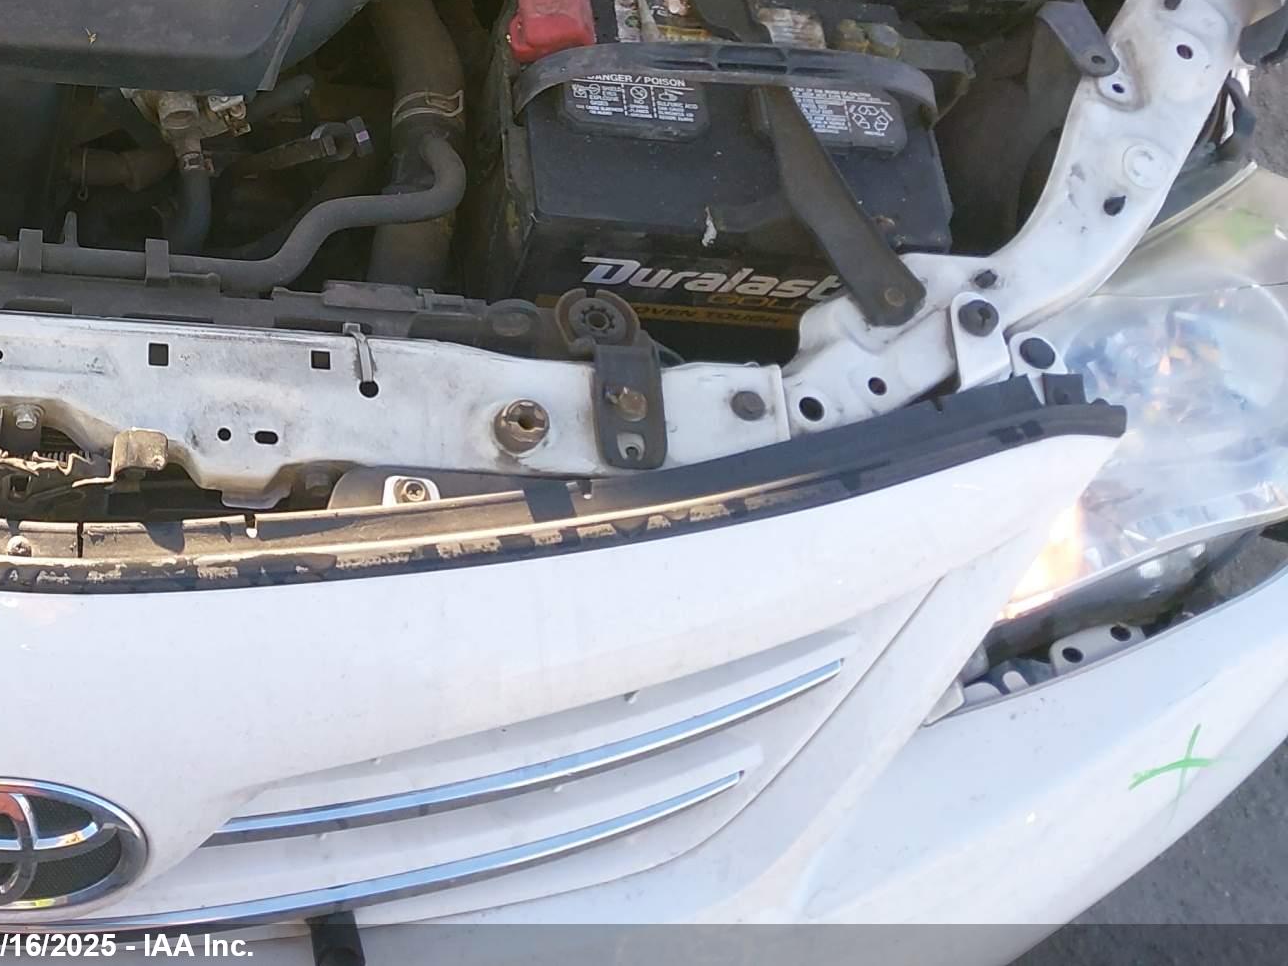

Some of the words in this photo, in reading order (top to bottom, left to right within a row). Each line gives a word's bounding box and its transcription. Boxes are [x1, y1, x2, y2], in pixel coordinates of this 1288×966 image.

[644, 76, 686, 87] POISON
[581, 256, 843, 301] Duralast
[707, 293, 805, 310] GOL
